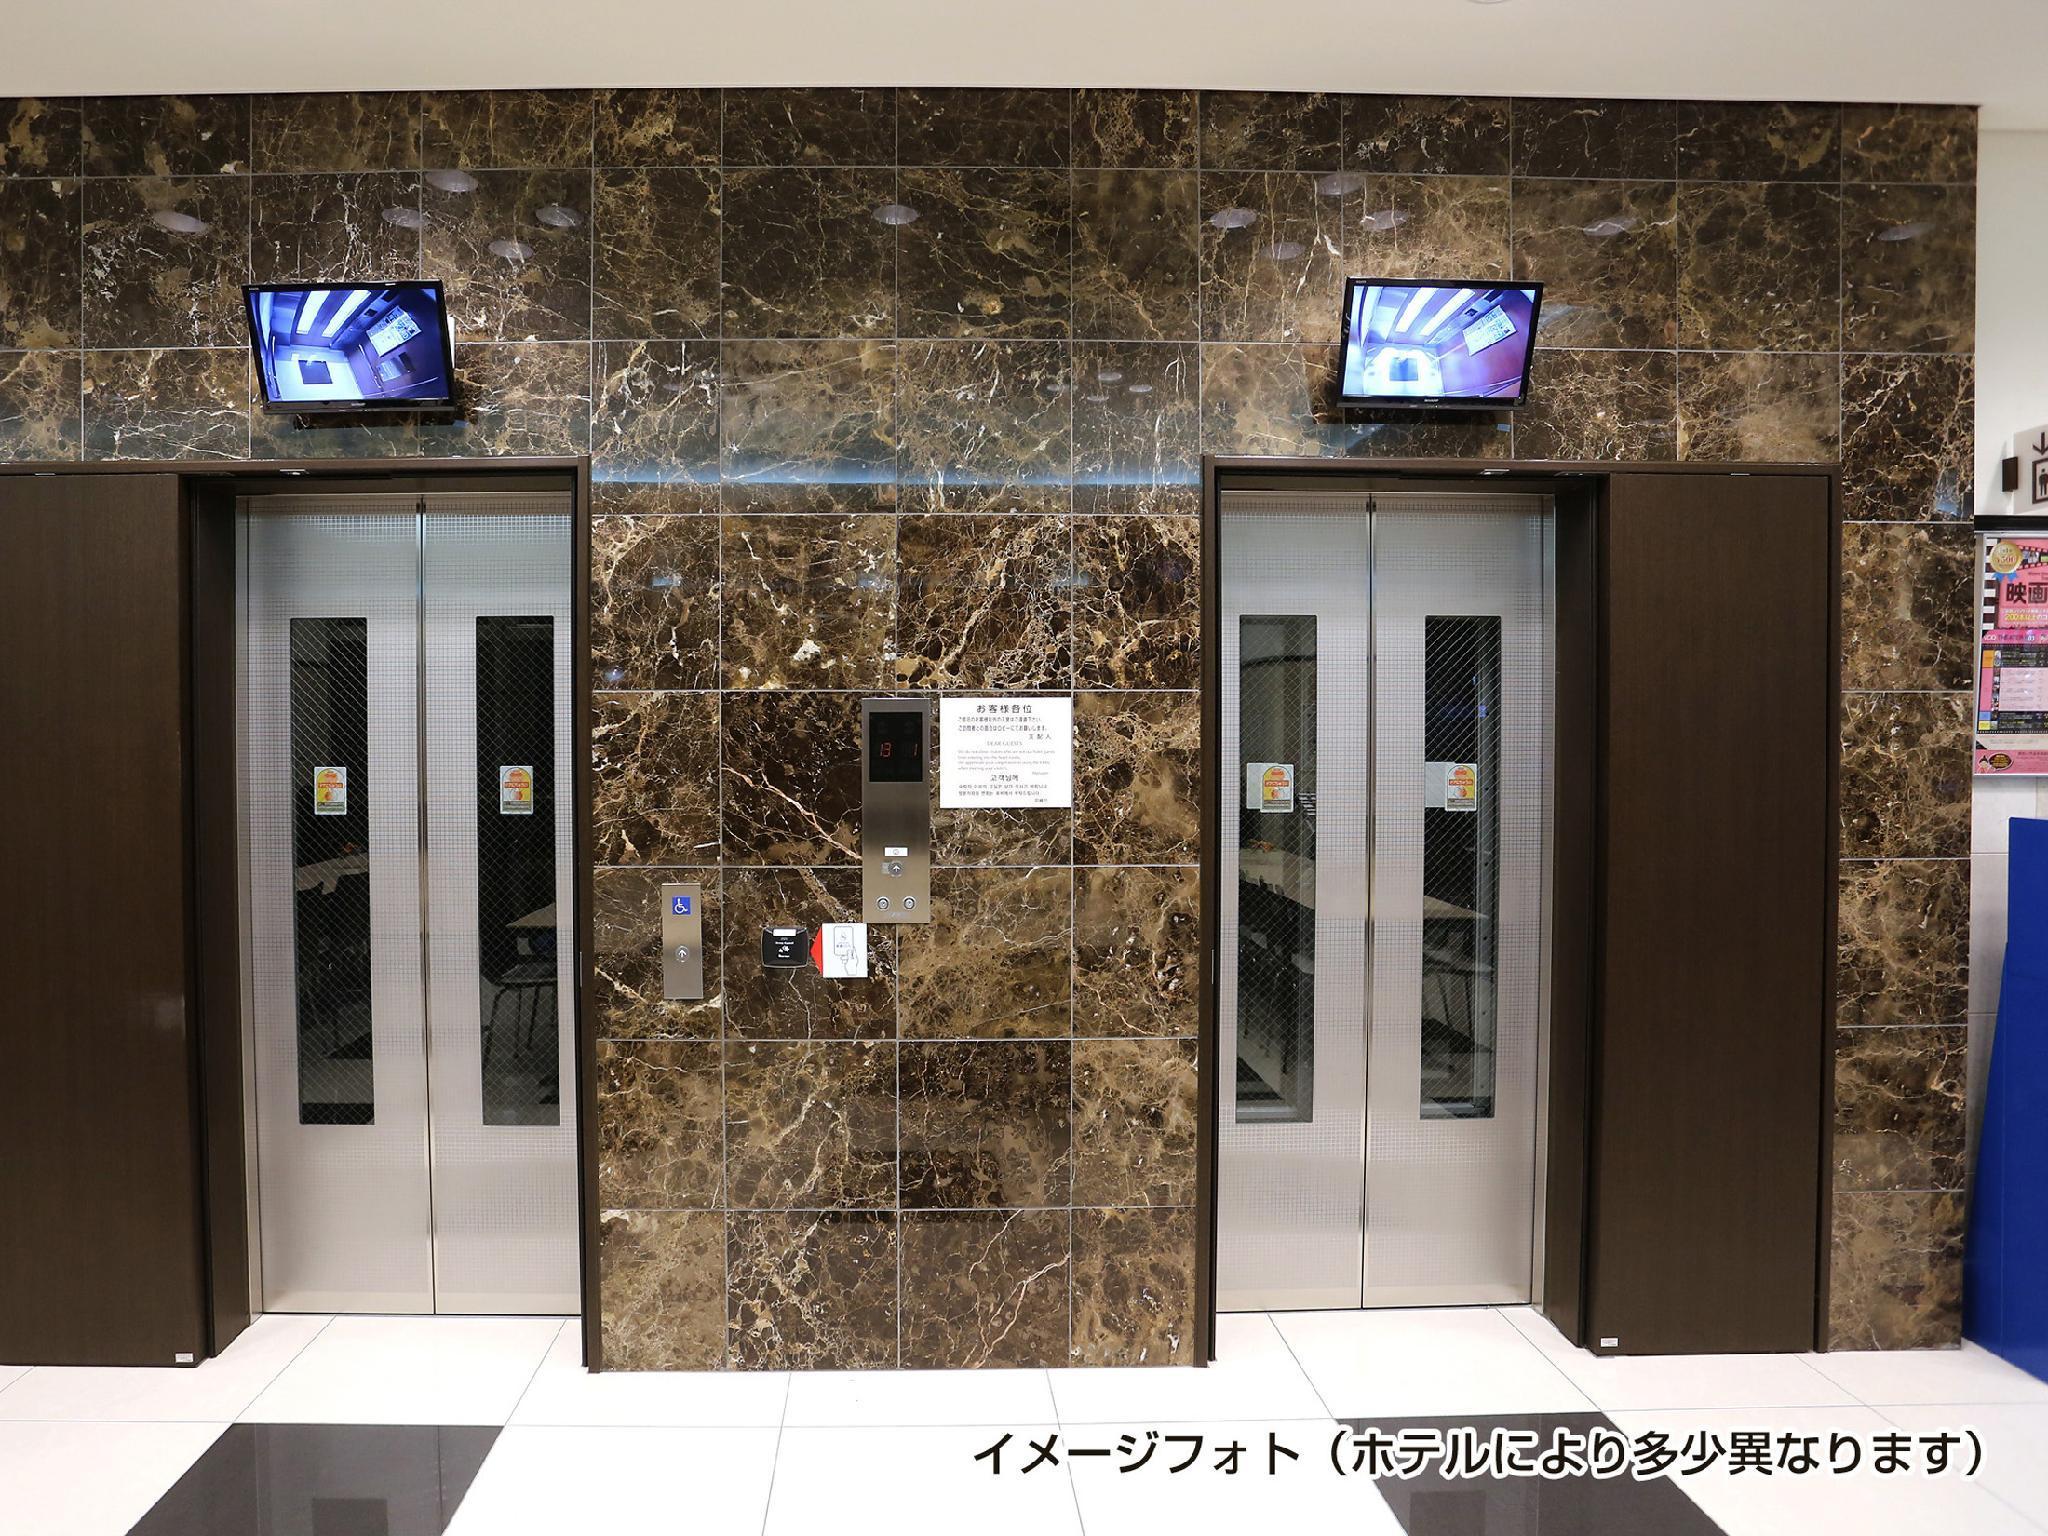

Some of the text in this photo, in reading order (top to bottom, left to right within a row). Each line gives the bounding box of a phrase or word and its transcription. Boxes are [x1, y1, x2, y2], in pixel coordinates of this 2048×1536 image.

[2006, 582, 2048, 604] 映画
[976, 704, 1032, 714] お客様各位
